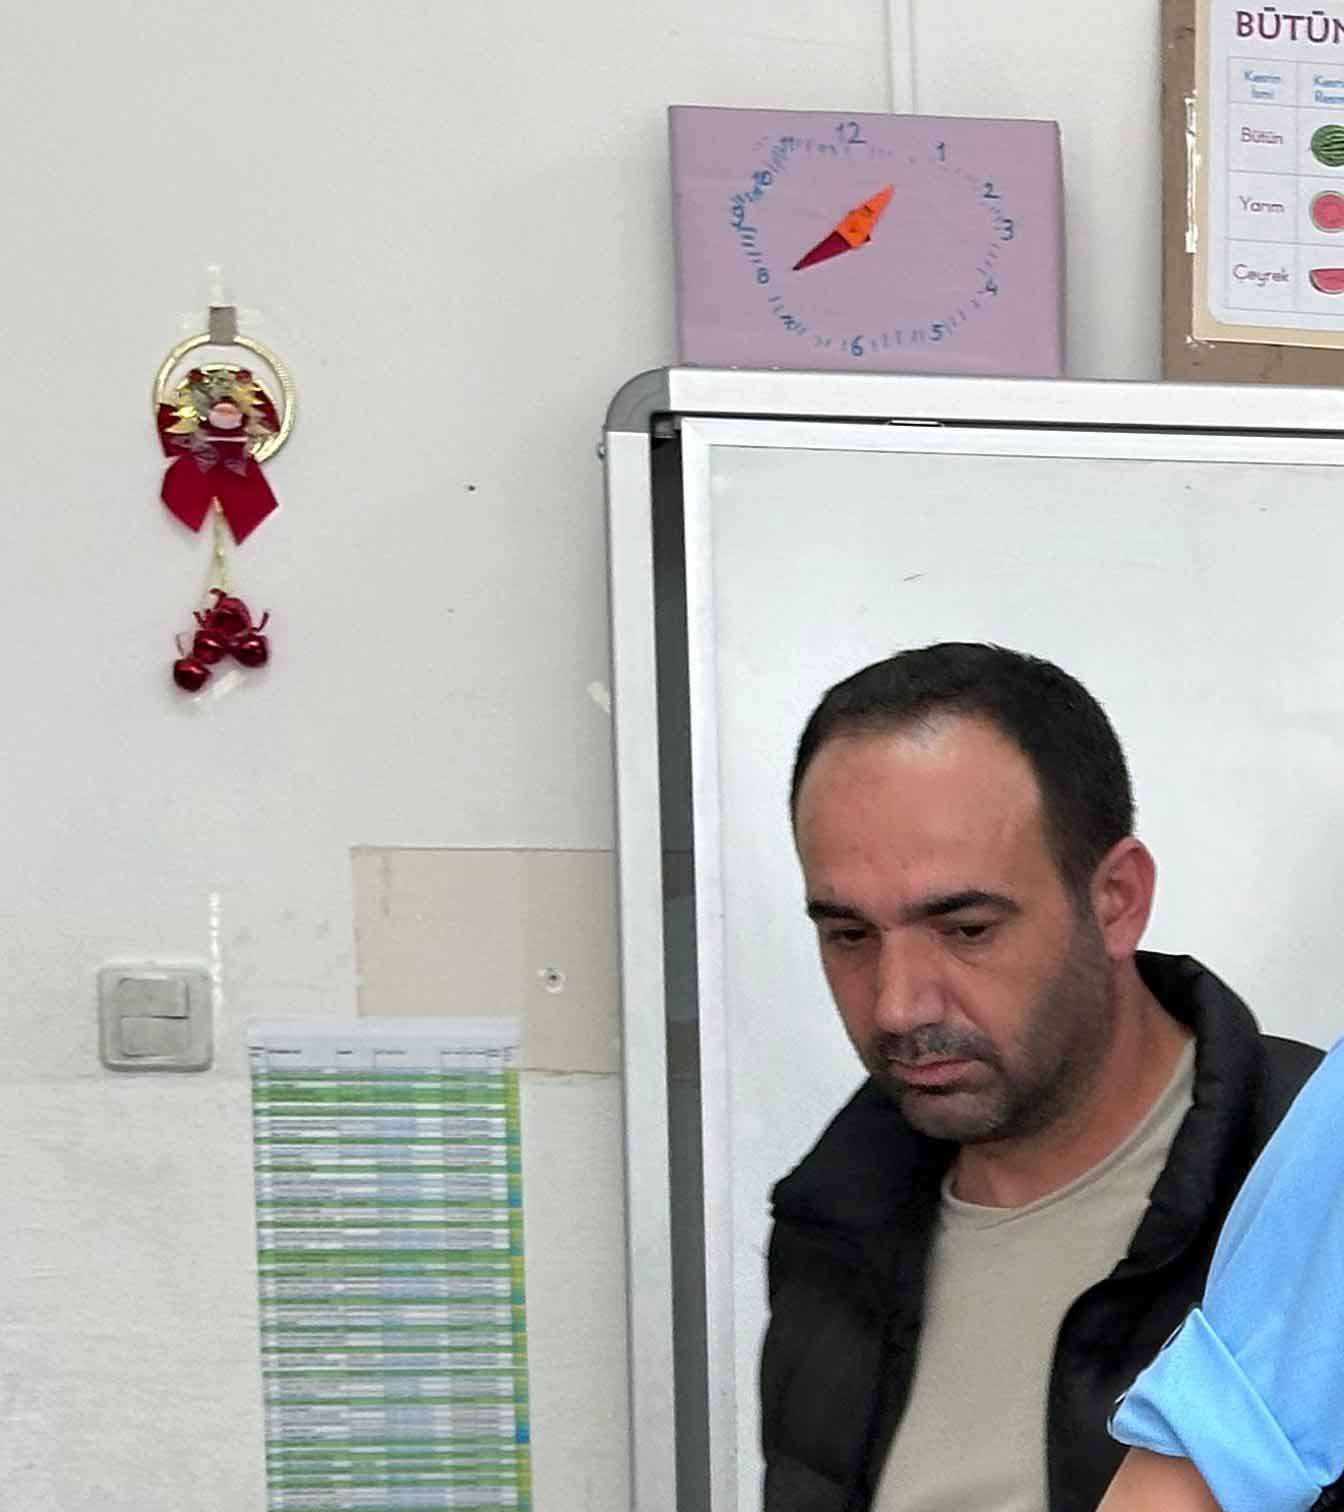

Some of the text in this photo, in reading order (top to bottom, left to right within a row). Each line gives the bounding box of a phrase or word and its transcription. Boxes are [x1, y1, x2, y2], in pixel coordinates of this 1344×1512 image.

[1240, 126, 1284, 145] Bütün
[982, 182, 1000, 199] 2
[1000, 218, 1015, 241] 3
[928, 322, 945, 342] 5
[850, 336, 865, 357] 6
